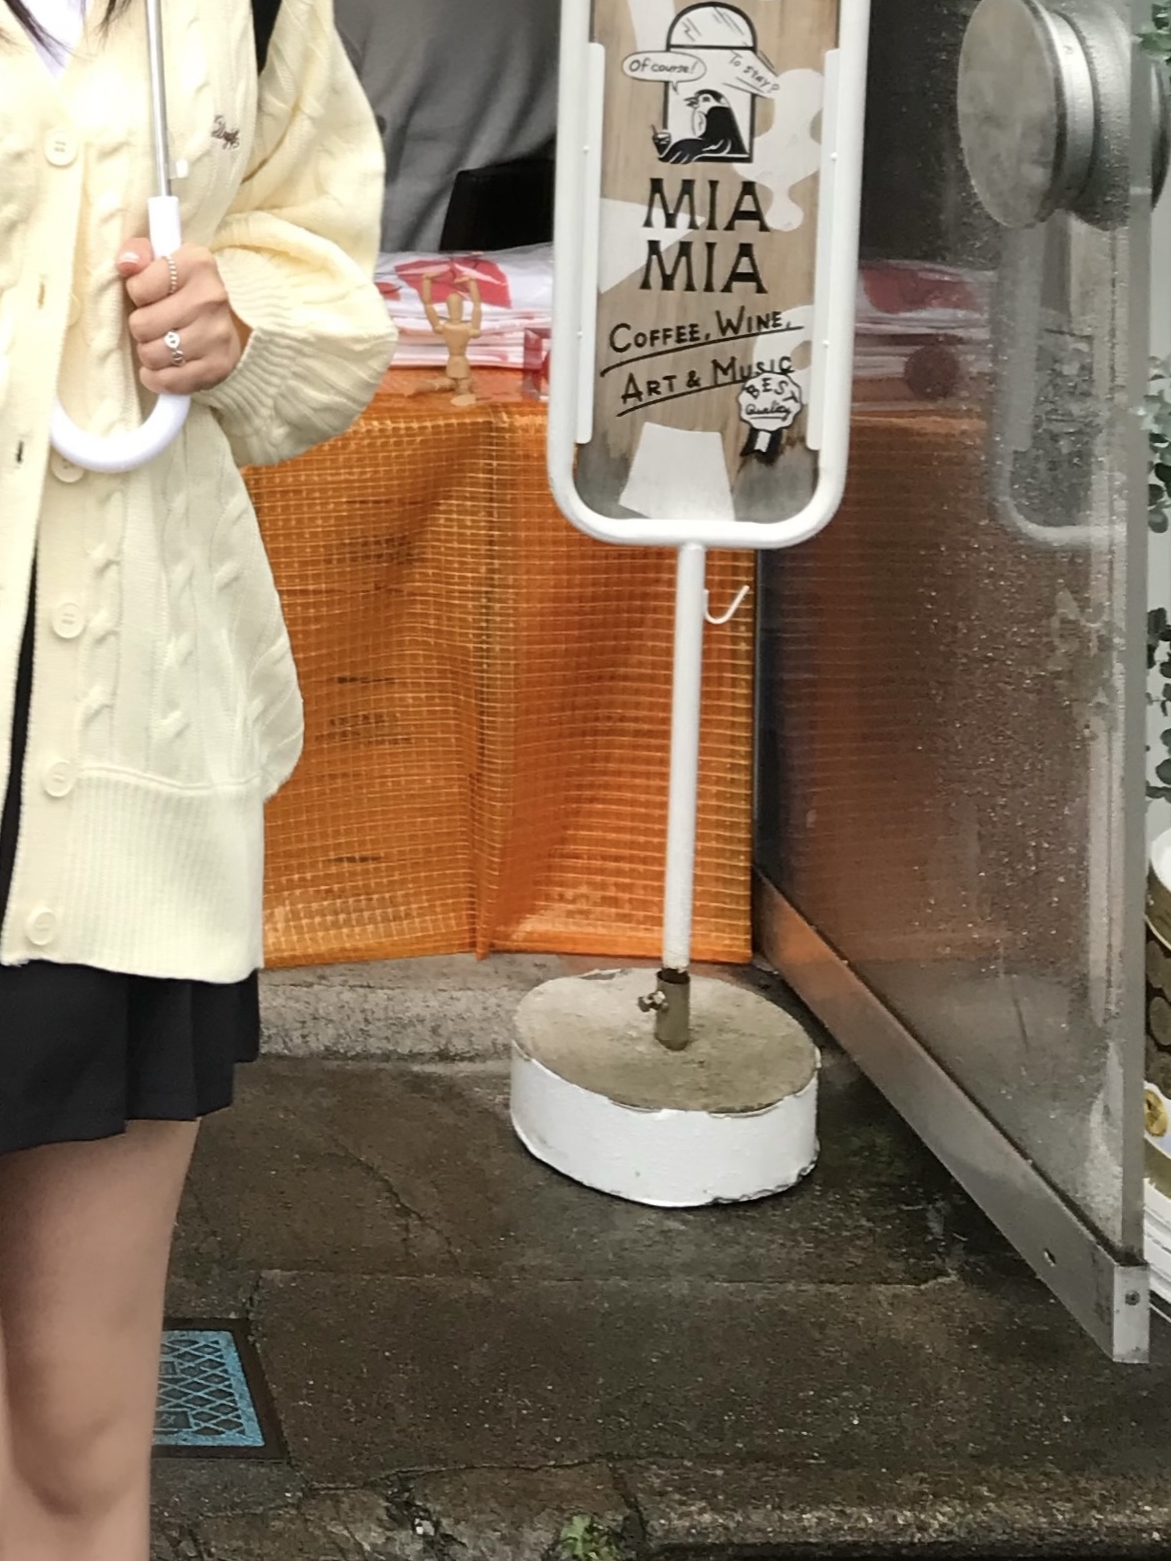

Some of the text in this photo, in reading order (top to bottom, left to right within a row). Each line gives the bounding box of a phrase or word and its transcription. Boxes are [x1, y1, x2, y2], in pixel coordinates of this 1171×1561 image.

[628, 57, 700, 75] Of course!
[729, 49, 744, 68] To
[642, 177, 771, 233] MIA
[638, 239, 769, 295] MIA
[620, 372, 678, 404] ART
[686, 370, 702, 388] &
[744, 376, 800, 404] BEST
